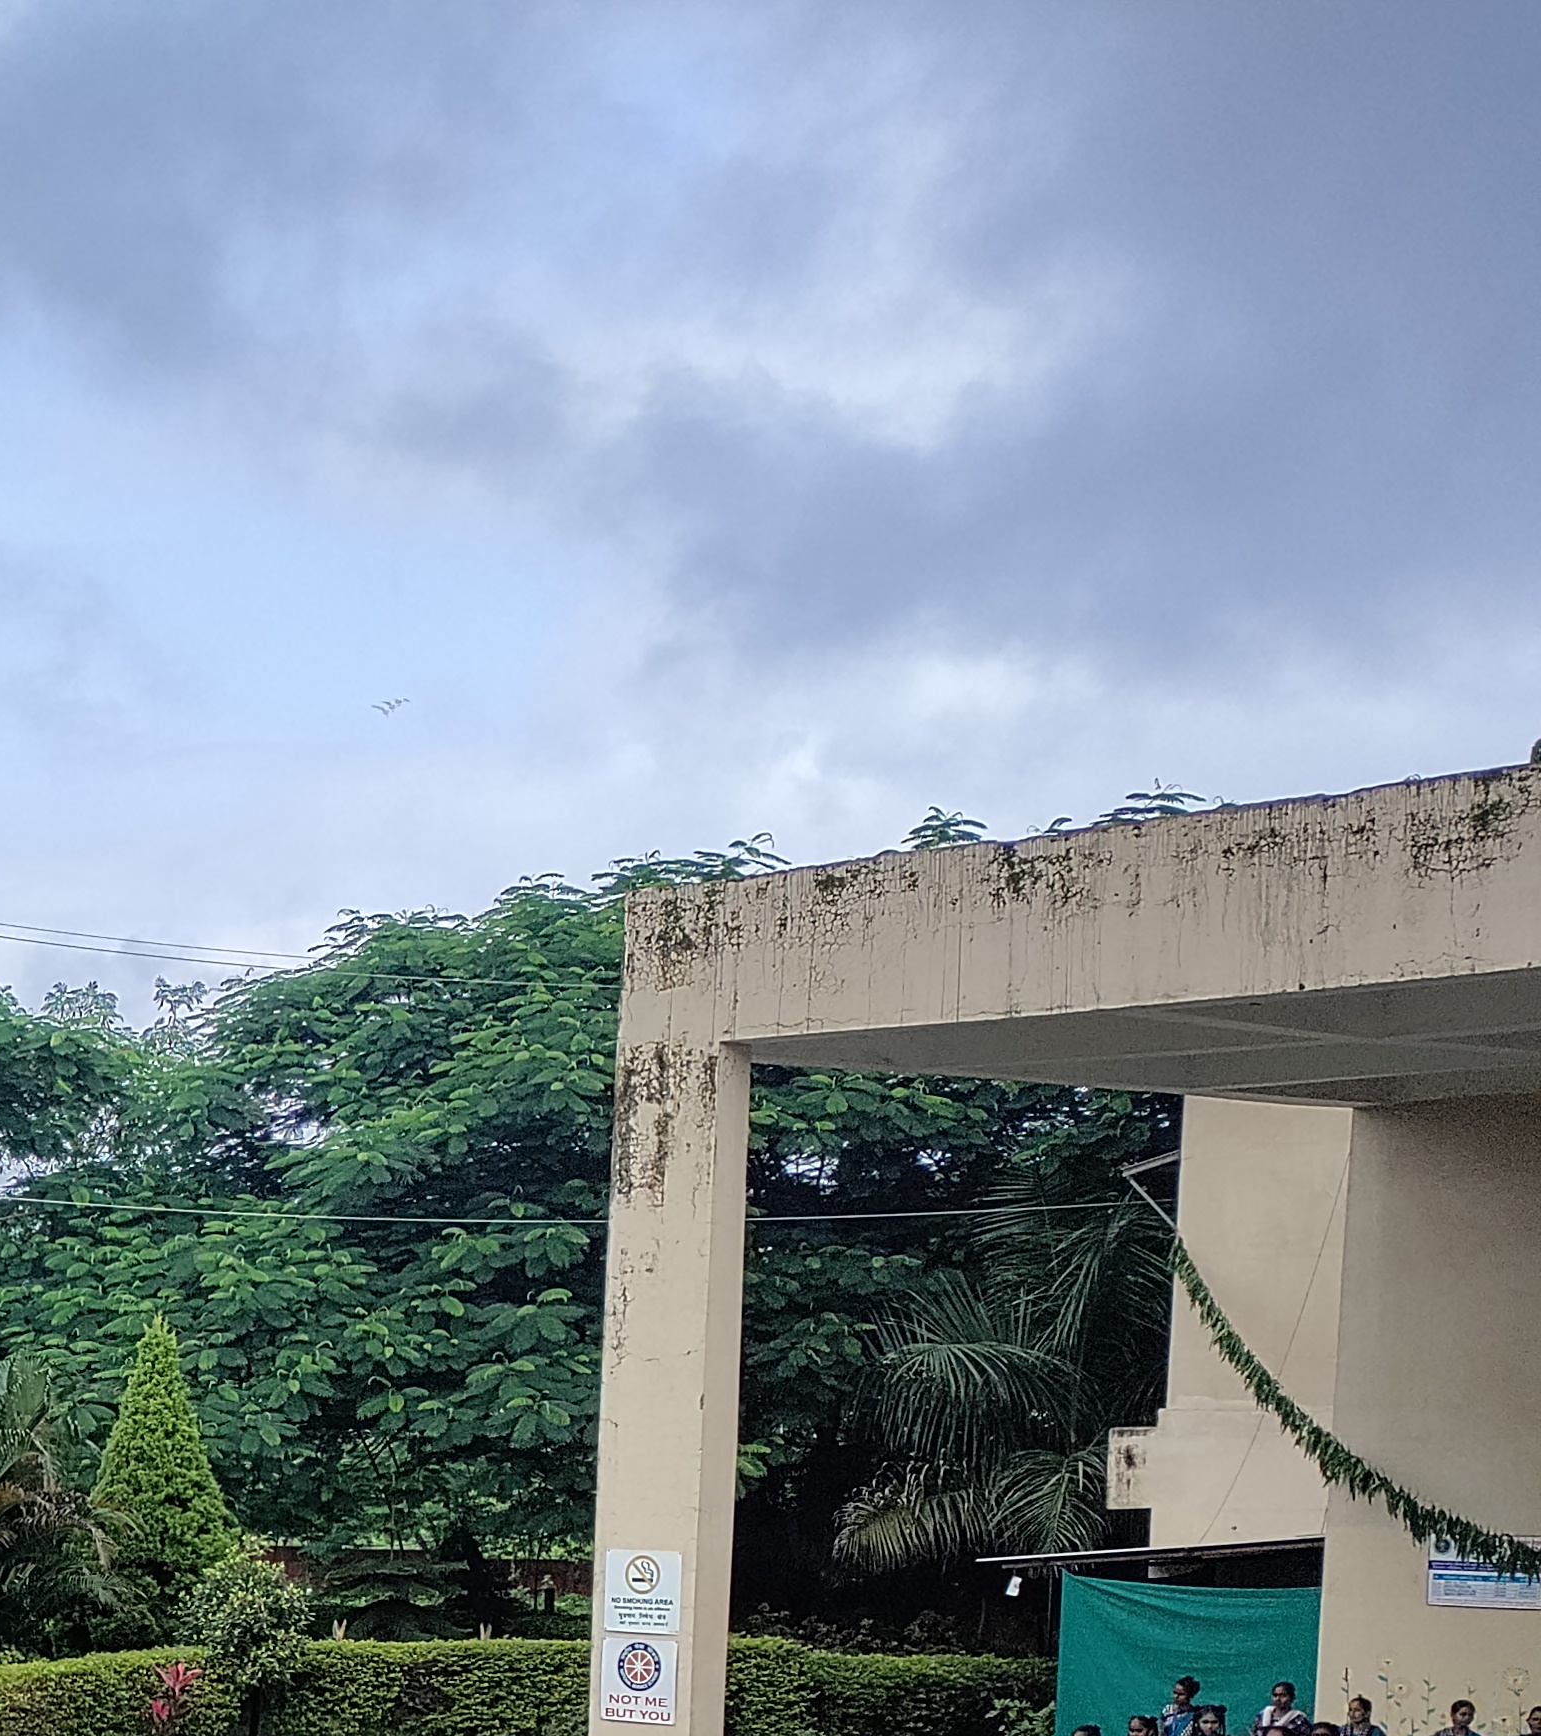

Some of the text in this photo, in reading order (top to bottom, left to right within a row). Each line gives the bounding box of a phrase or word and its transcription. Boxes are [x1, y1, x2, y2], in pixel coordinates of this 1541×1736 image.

[622, 1597, 654, 1605] SMOKING
[654, 1598, 674, 1606] AREA
[609, 1694, 668, 1707] NOT ME
[605, 1707, 671, 1722] BUT YOU
